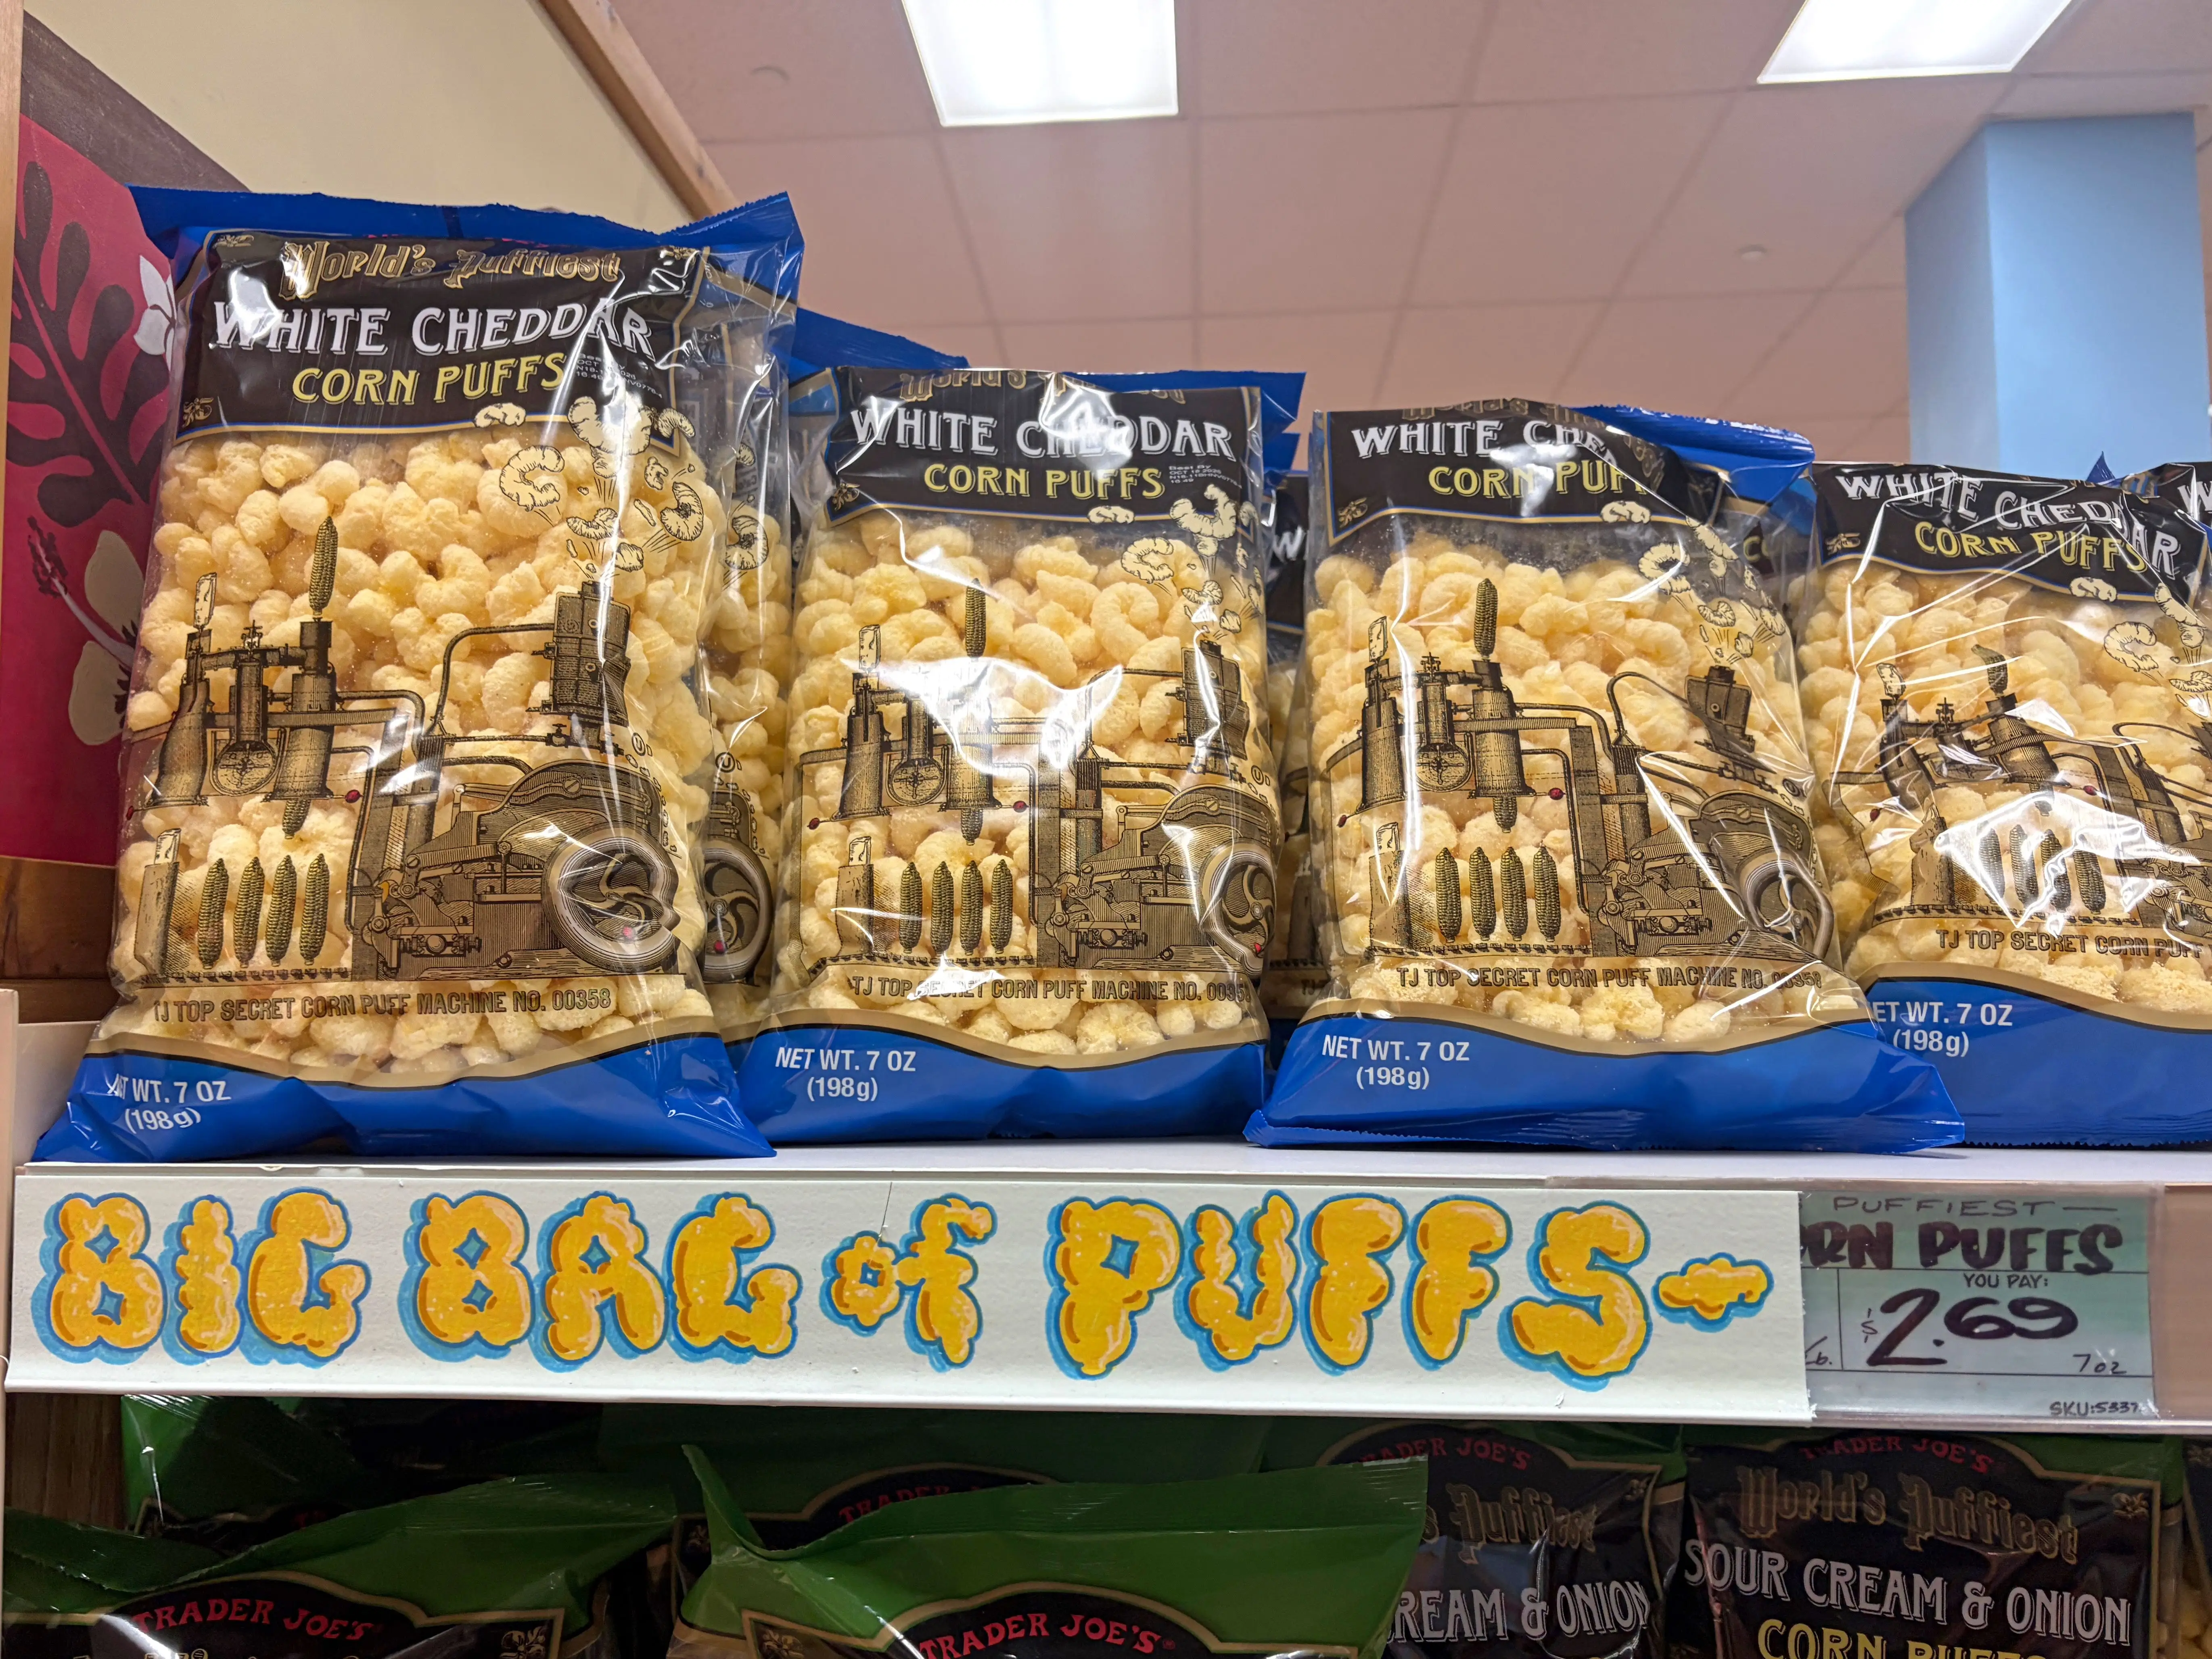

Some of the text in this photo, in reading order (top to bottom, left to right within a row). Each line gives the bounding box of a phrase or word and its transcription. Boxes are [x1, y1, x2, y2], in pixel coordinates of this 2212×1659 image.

[278, 241, 436, 300] World's
[208, 299, 655, 362] WHITE CHEDDAR
[292, 353, 567, 405] CORN PUFFS
[851, 408, 1237, 462] WHITE CHEDDAR
[1351, 420, 1503, 459] WHITE
[924, 464, 1036, 497] CORN
[1045, 468, 1165, 499] PUFFS
[1428, 465, 1535, 499] CORN
[1835, 472, 1984, 524] WHITE
[1994, 490, 2181, 580] CHEDDAR
[1914, 521, 2147, 574] CORN PUFFS
[1936, 929, 1959, 949] TJ
[1965, 930, 2004, 950] TOP
[2011, 930, 2088, 953] SECRET
[2094, 935, 2149, 957] CORN
[2154, 938, 2204, 959] PUFF
[852, 976, 873, 996] TJ
[878, 977, 912, 997] TOP
[991, 979, 1037, 999] CORN
[1043, 980, 1087, 999] PUFF
[1092, 980, 1168, 1001] MACHINE
[1173, 980, 1202, 1001] NO.
[1397, 967, 1418, 987] TJ
[1424, 967, 1461, 988] TOP
[1467, 967, 1541, 988] SECRET
[1547, 967, 1598, 988] CORN
[1602, 968, 1651, 988] PUFF
[1657, 967, 1737, 988] MACHINE
[1741, 968, 1768, 989] NO.
[153, 988, 611, 1022] TJ TOP SECRET CORN PUFF MACHINE NO. 00358
[1868, 1001, 2013, 1027] ET WT. 7 OZ
[776, 1047, 916, 1072] NET WT. 7 OZ
[1322, 1035, 1470, 1061] NET WT. 7 OZ
[132, 1078, 170, 1103] WT.
[174, 1081, 188, 1103] 7
[196, 1080, 232, 1102] OZ
[1834, 1196, 2055, 1217] PUFFIEST
[1800, 1221, 2123, 1275] RN PUFFS
[30, 1185, 1654, 1393] BIG BAG of PUFFS
[1964, 1273, 2049, 1289] YOU PAY:
[2072, 1354, 2091, 1372] 7
[1456, 1437, 1532, 1471] JOE'S
[1798, 1435, 1995, 1475] TRADER JOE'S
[1737, 1466, 2079, 1566] World's Puffiest
[1387, 1579, 1652, 1644] REAM & ONION
[1684, 1538, 2133, 1646] SOUR CREAM & ONION
[130, 1598, 375, 1640] TRADER JOE'S
[919, 1613, 1162, 1659] TRADER JOE'S
[1757, 1618, 1886, 1659] CORN
